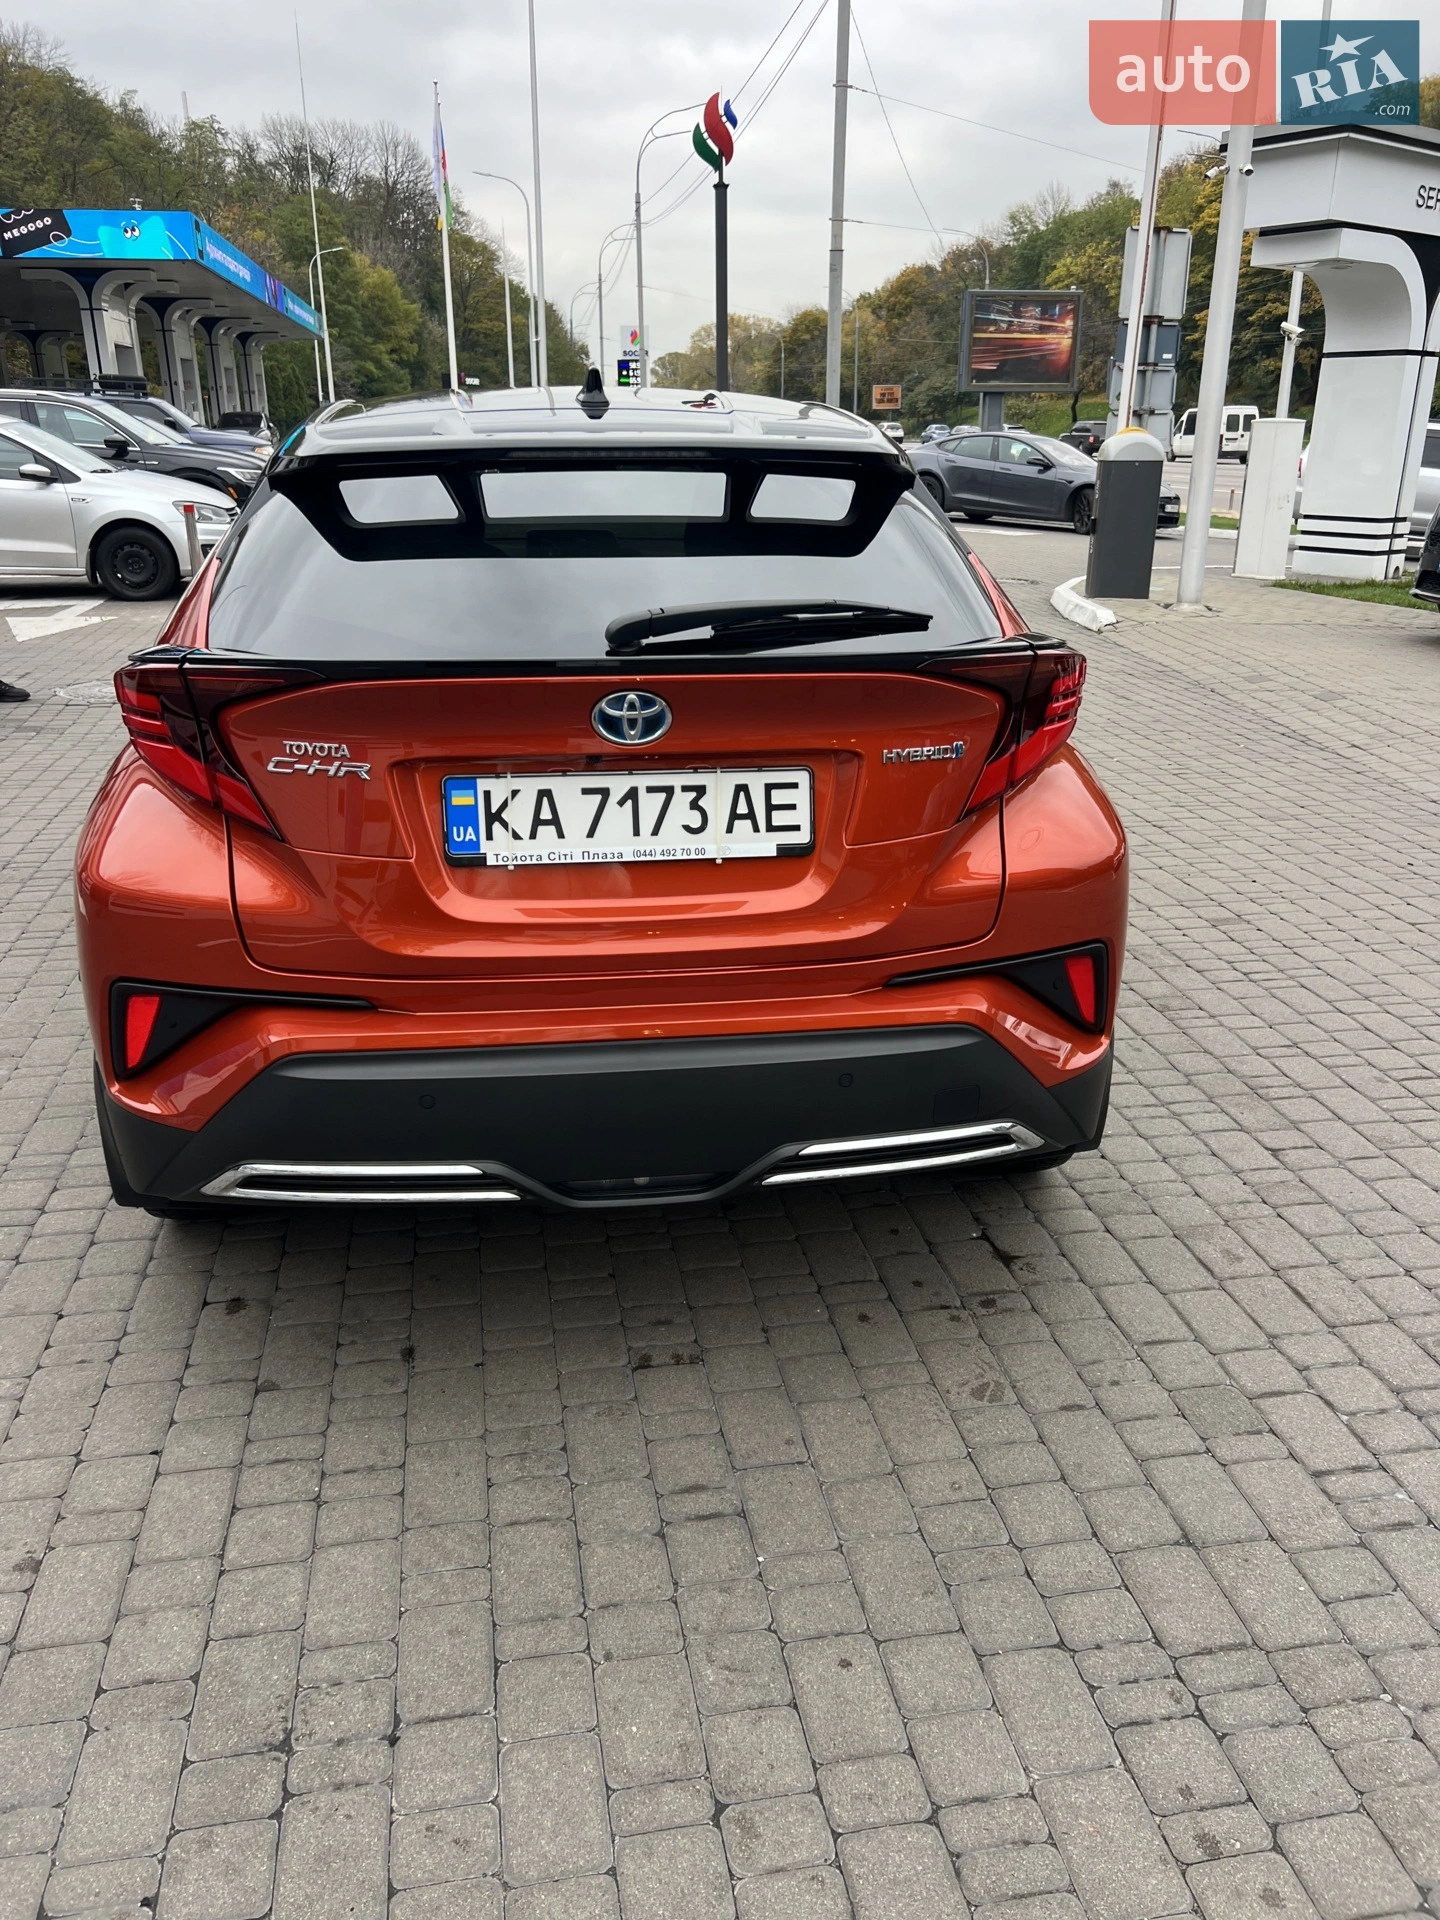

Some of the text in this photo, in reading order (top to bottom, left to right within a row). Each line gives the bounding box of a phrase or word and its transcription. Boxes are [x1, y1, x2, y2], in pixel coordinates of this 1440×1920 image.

[3, 216, 52, 240] MEGOGO
[282, 740, 351, 758] TOYOTA
[882, 745, 952, 763] HYBRID
[266, 756, 371, 781] C-HR
[483, 782, 801, 841] KA 7173 AE
[452, 826, 477, 842] UA
[493, 847, 706, 863] Тойота Сіті Плаза (044) 492 70 00
